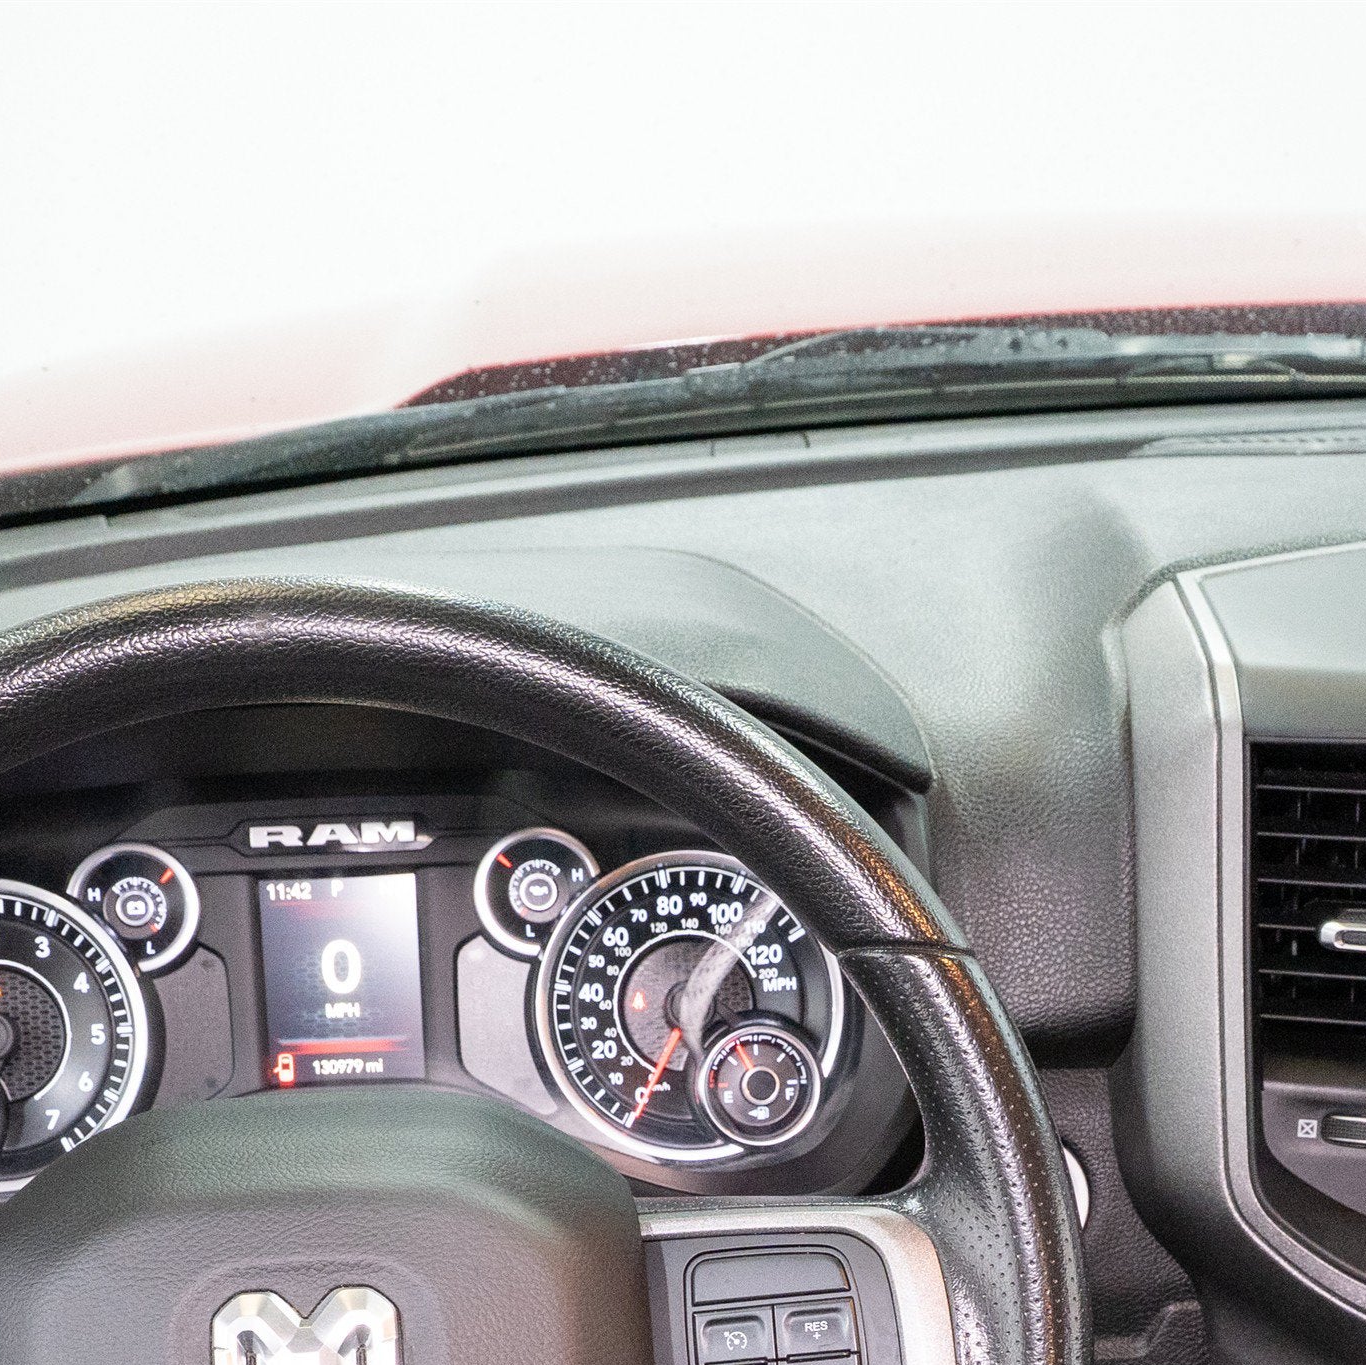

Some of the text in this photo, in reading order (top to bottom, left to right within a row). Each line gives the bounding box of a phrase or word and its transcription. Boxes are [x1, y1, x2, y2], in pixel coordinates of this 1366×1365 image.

[249, 821, 416, 848] RAM
[571, 867, 584, 882] H
[87, 887, 102, 902] H
[266, 882, 312, 901] 11:42
[331, 879, 344, 898] P
[656, 894, 683, 917] 80
[689, 892, 707, 907] 90
[630, 908, 648, 923] 70
[707, 901, 743, 925] 100
[525, 923, 536, 938] L
[650, 922, 668, 934] 120
[680, 918, 700, 930] 140
[602, 926, 630, 948] 60
[34, 936, 51, 958] 3
[146, 940, 156, 955] L
[614, 946, 633, 958] 100
[588, 954, 606, 969] 50
[746, 943, 784, 967] 120
[321, 939, 362, 995] 0
[606, 964, 620, 977] 80
[73, 972, 90, 993] 4
[762, 976, 798, 993] MPH
[578, 982, 605, 1004] 40
[325, 1002, 361, 1019] MPH
[598, 999, 613, 1012] 60
[580, 1016, 598, 1031] 30
[90, 1023, 106, 1045] 5
[604, 1026, 618, 1039] 40
[591, 1039, 619, 1061] 20
[312, 1058, 384, 1075] 130979 mi
[620, 1055, 634, 1067] 20
[78, 1070, 94, 1092] 6
[608, 1071, 624, 1086] 10
[723, 1090, 734, 1104] E
[785, 1087, 795, 1101] F
[45, 1109, 61, 1130] 7
[804, 1321, 829, 1333] RES
